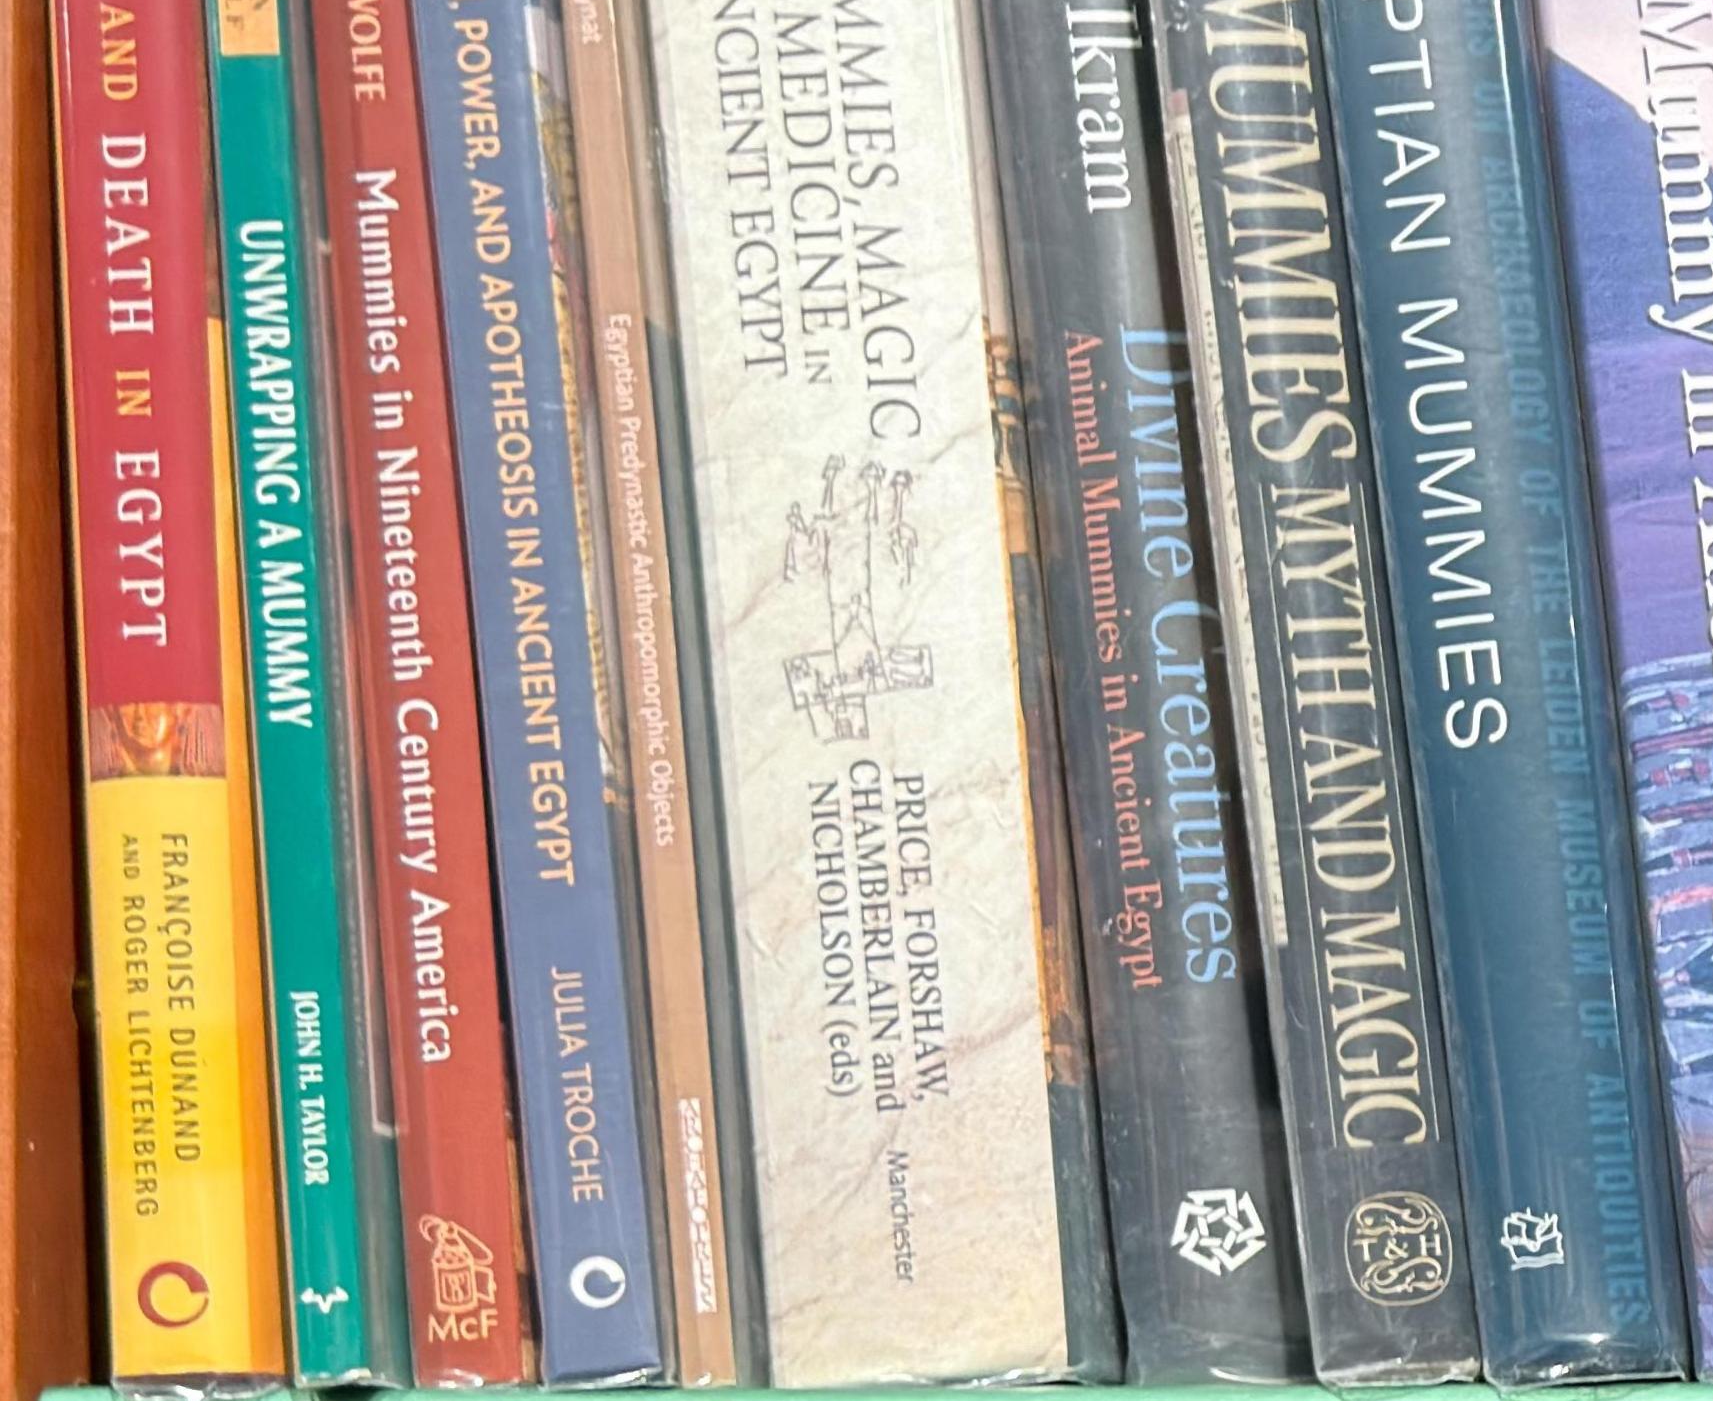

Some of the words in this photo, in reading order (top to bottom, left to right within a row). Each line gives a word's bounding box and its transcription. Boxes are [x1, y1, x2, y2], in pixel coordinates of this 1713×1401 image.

[98, 1, 139, 103] AND
[455, 19, 502, 183] POWER,
[1064, 2, 1142, 213] Ikram
[100, 132, 157, 336] DEATH
[471, 182, 512, 266] AND
[772, 9, 852, 336] MEDICINE
[354, 169, 408, 375] Mummies
[730, 210, 790, 378] EGYPT
[852, 221, 922, 442] MAGIC
[116, 368, 152, 419] IN
[238, 219, 301, 505] UNWRAPPING
[372, 390, 414, 430] in
[480, 275, 539, 516] APOTHEOSIS
[604, 311, 635, 412] Egyptian
[804, 347, 834, 387] IN
[258, 519, 303, 548] A
[614, 413, 650, 549] Predynastic
[1119, 322, 1196, 584] Divine
[1398, 297, 1509, 749] MUMMIES
[114, 450, 168, 647] EGYPT
[376, 447, 434, 682] Nineteenth
[506, 528, 543, 568] IN
[1267, 482, 1377, 713] MYTH
[259, 560, 313, 728] MUMMY
[511, 579, 561, 749] ANCIENT
[630, 550, 666, 757] Anthropomorphic
[122, 833, 141, 880] AND
[396, 701, 439, 874] Century
[528, 763, 576, 888] EGYPT
[649, 759, 676, 848] Objects
[894, 771, 933, 898] PRICE,
[1149, 601, 1237, 985] Creatures
[1300, 726, 1396, 892] AND
[122, 894, 150, 995] ROGER
[157, 833, 195, 1013] FRANÇOISE
[808, 780, 857, 1006] NICHOLSON
[848, 758, 903, 1044] CHAMBERLAIN
[290, 990, 323, 1061] JOHN
[409, 889, 459, 1064] America
[551, 966, 587, 1058] JULIA
[820, 1018, 861, 1098] (eds)
[900, 906, 950, 1102] FORSHAW,
[1320, 906, 1428, 1148] MAGIC
[126, 1010, 160, 1217] LICHTENBERG
[169, 1027, 201, 1164] DUNAND
[297, 1061, 324, 1091] H.
[300, 1092, 329, 1186] TAYLOR
[560, 1061, 604, 1204] TROCHE
[872, 1050, 906, 1112] and
[886, 1150, 916, 1286] Manchester
[428, 1308, 498, 1343] McF
